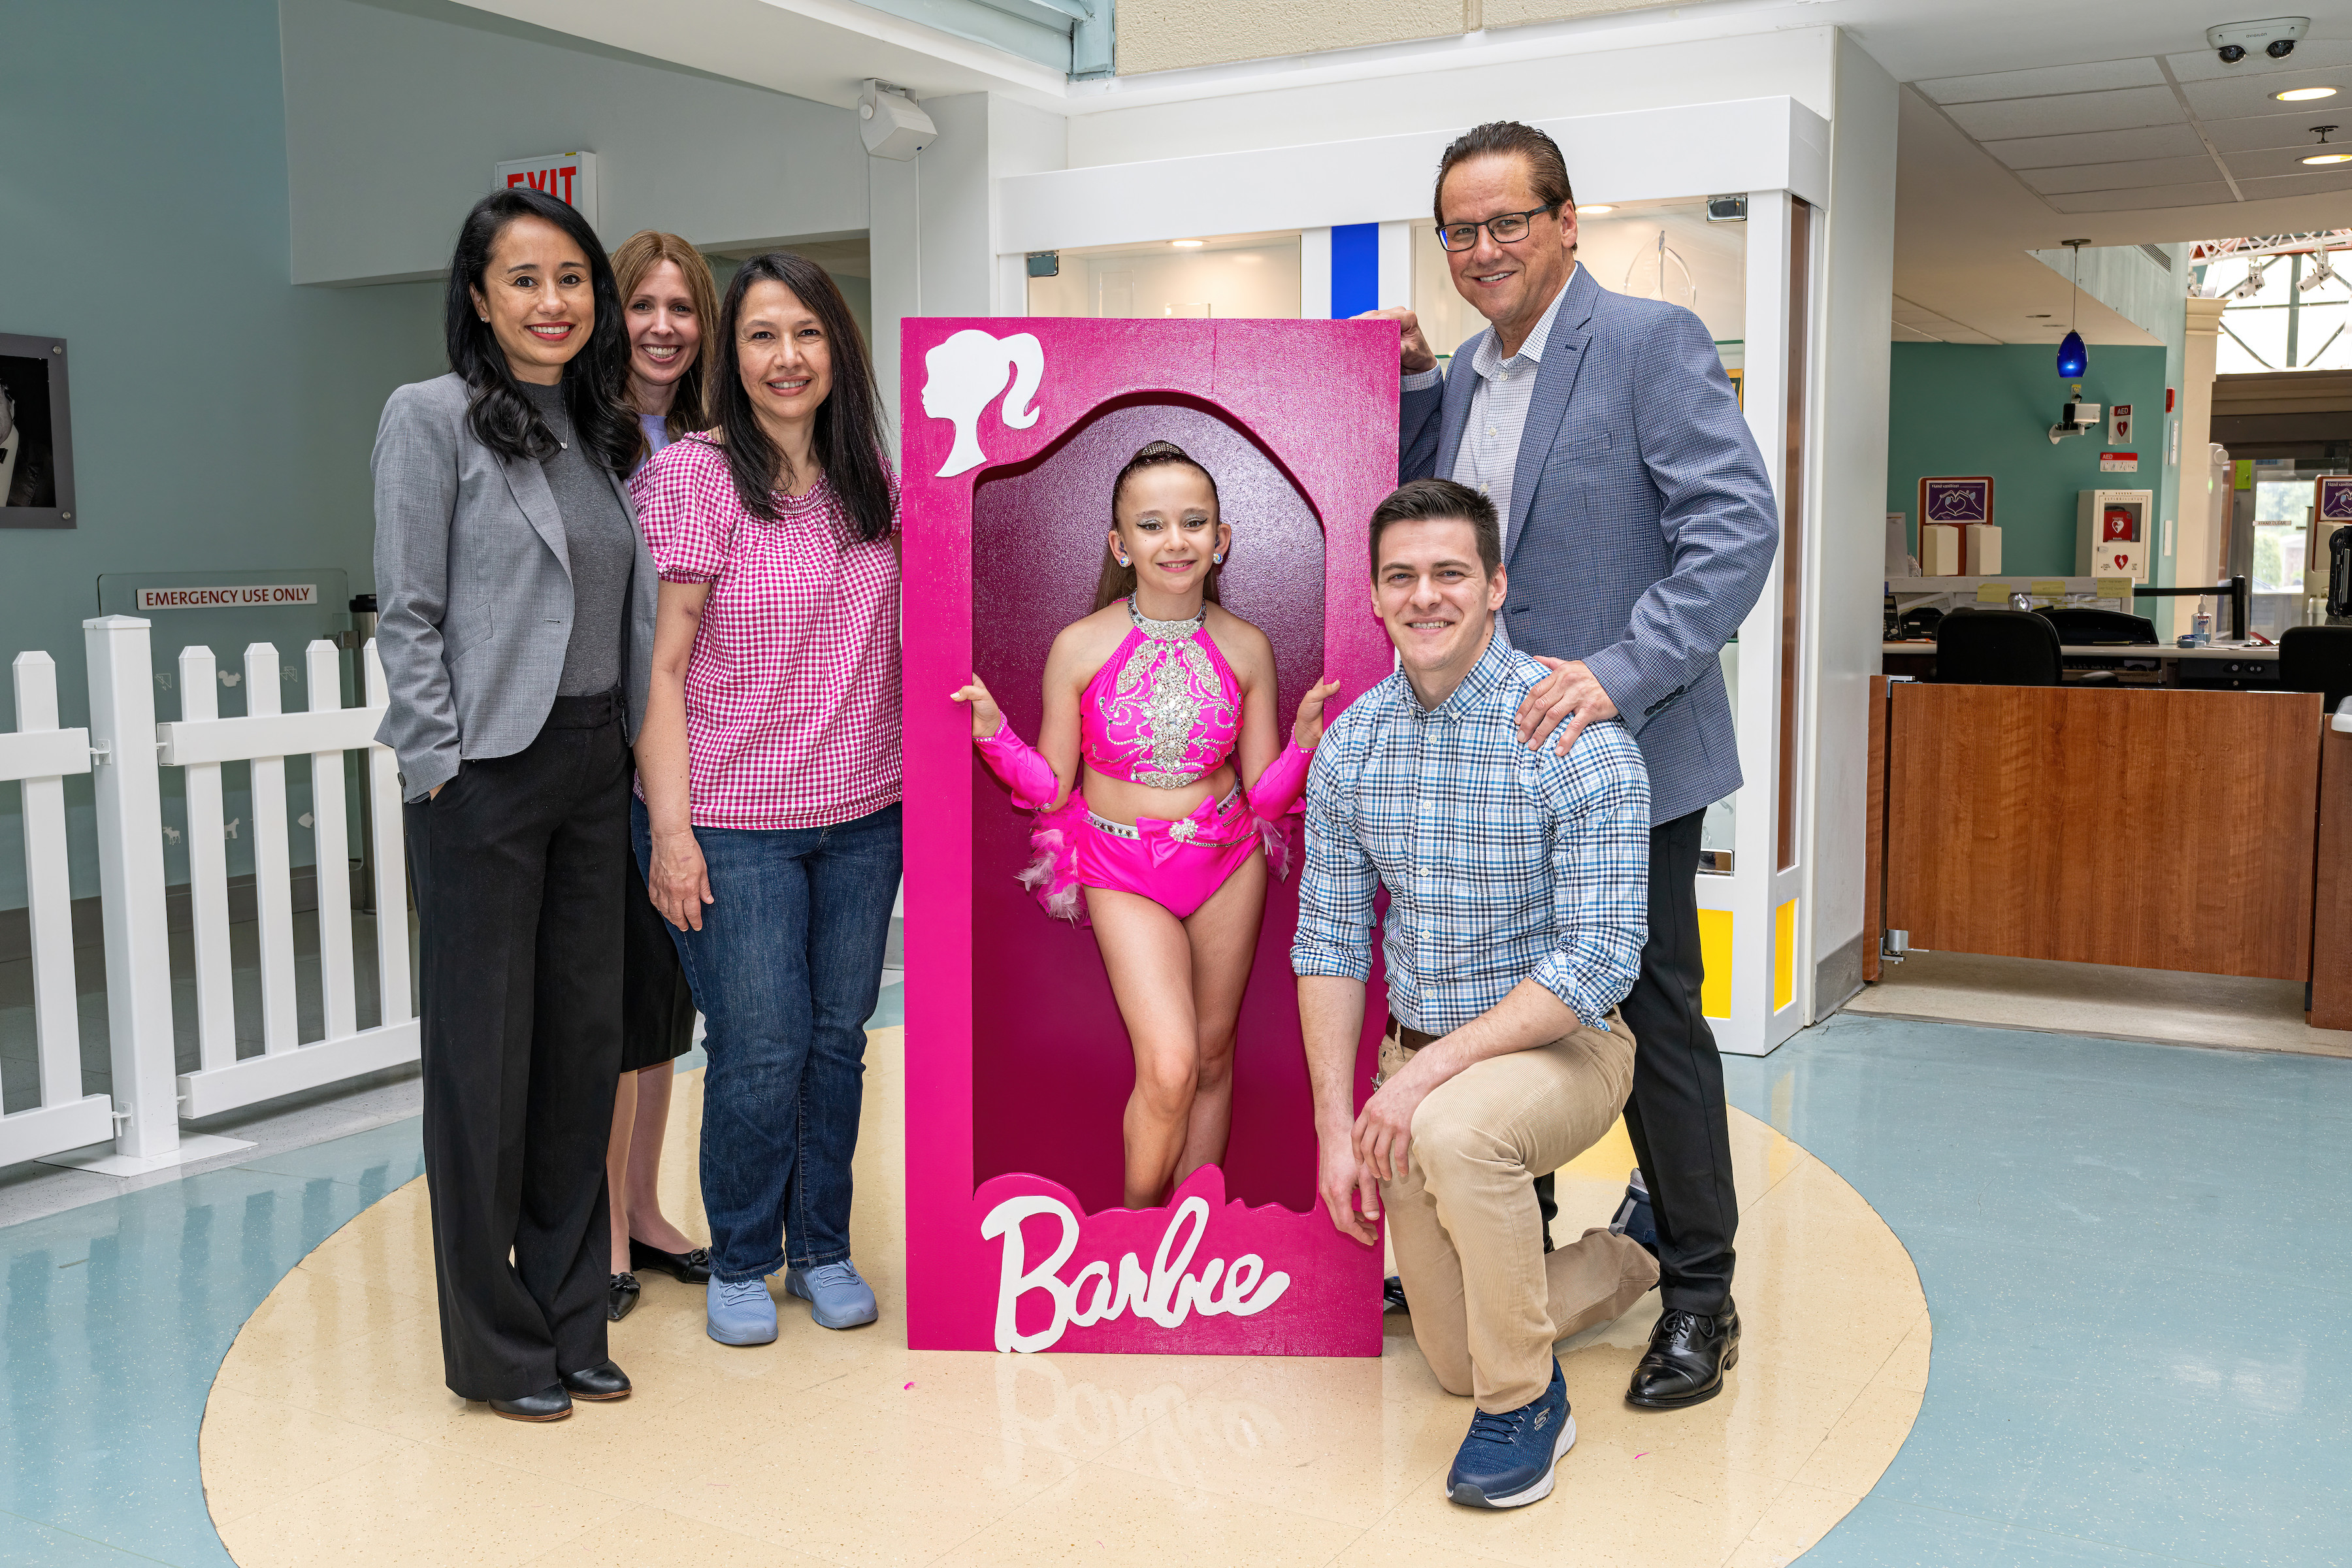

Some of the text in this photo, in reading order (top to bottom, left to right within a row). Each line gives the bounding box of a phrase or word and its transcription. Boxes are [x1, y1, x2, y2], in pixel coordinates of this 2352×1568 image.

[507, 166, 576, 206] IT
[146, 587, 310, 606] EMERGENCY USE ONLY
[980, 1195, 1291, 1353] Barbie
